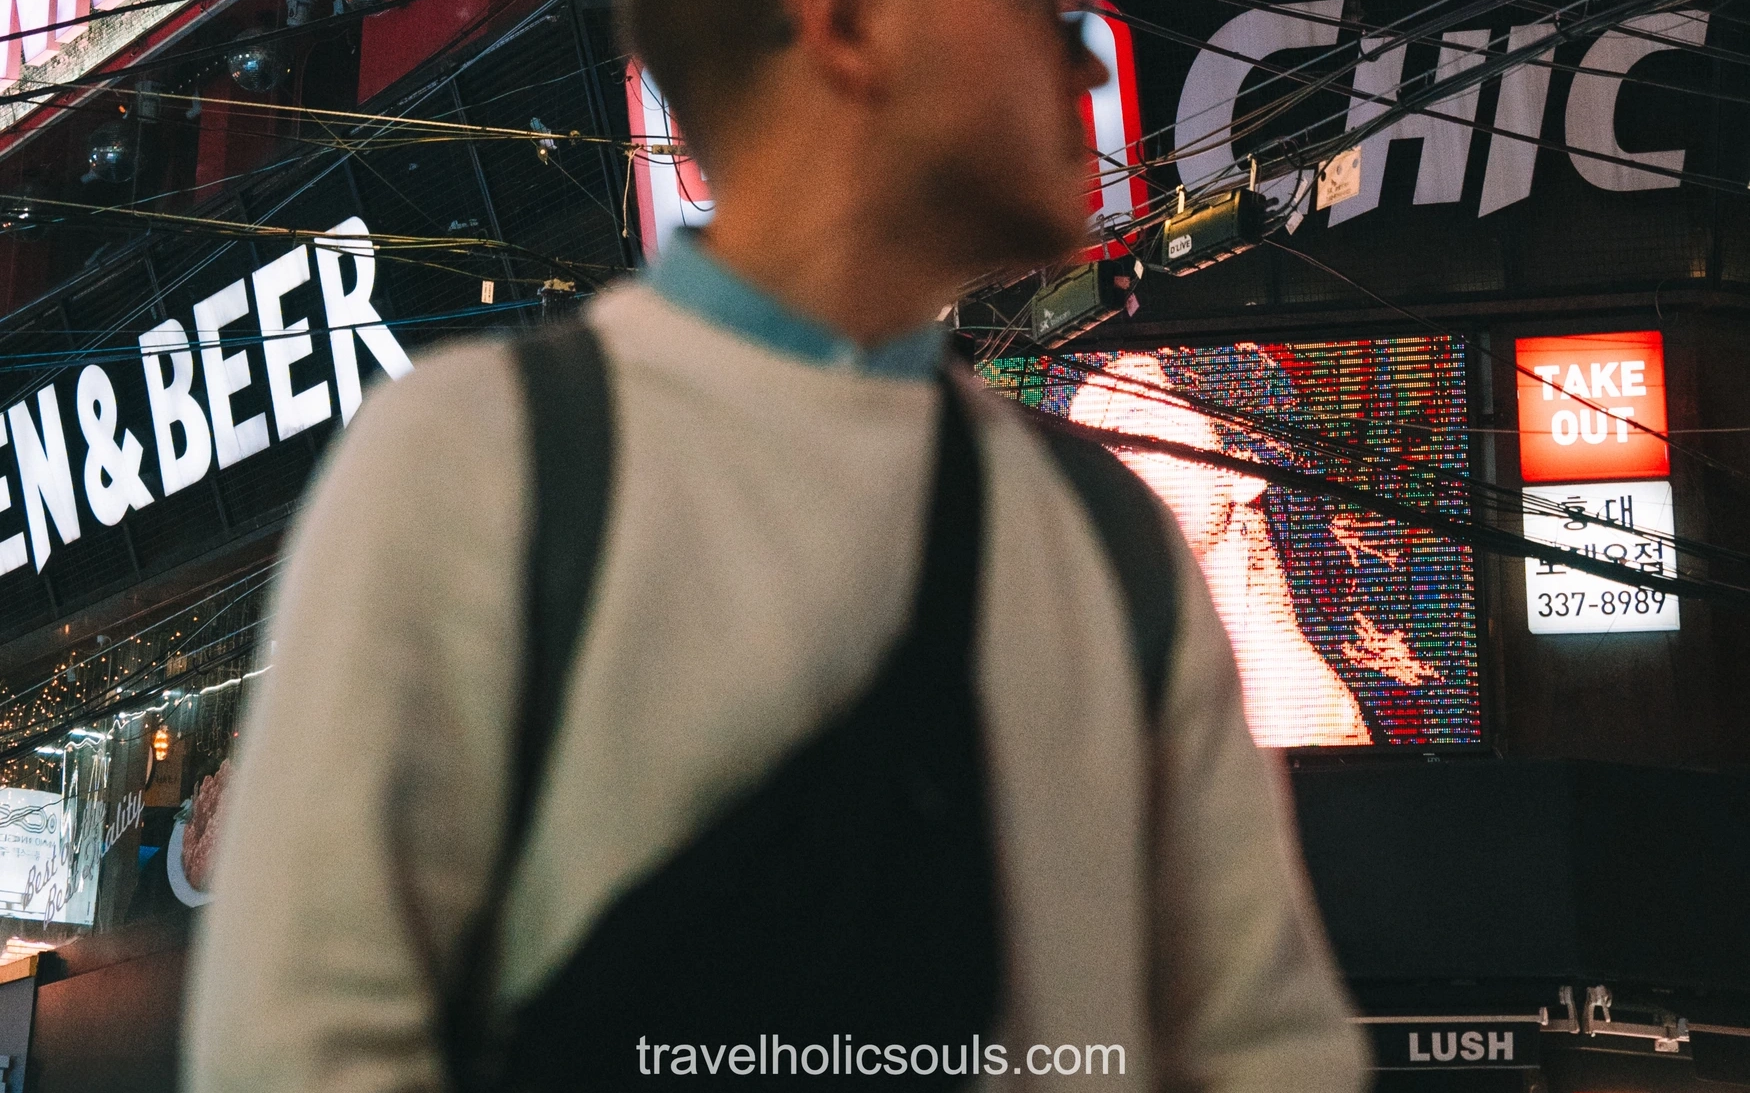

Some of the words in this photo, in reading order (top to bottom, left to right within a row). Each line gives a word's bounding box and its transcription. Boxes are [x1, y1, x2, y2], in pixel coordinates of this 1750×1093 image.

[1534, 360, 1647, 401] TAKE
[1551, 406, 1635, 446] OUT
[1538, 590, 1666, 617] 337-8989
[1409, 1031, 1514, 1062] LUSH
